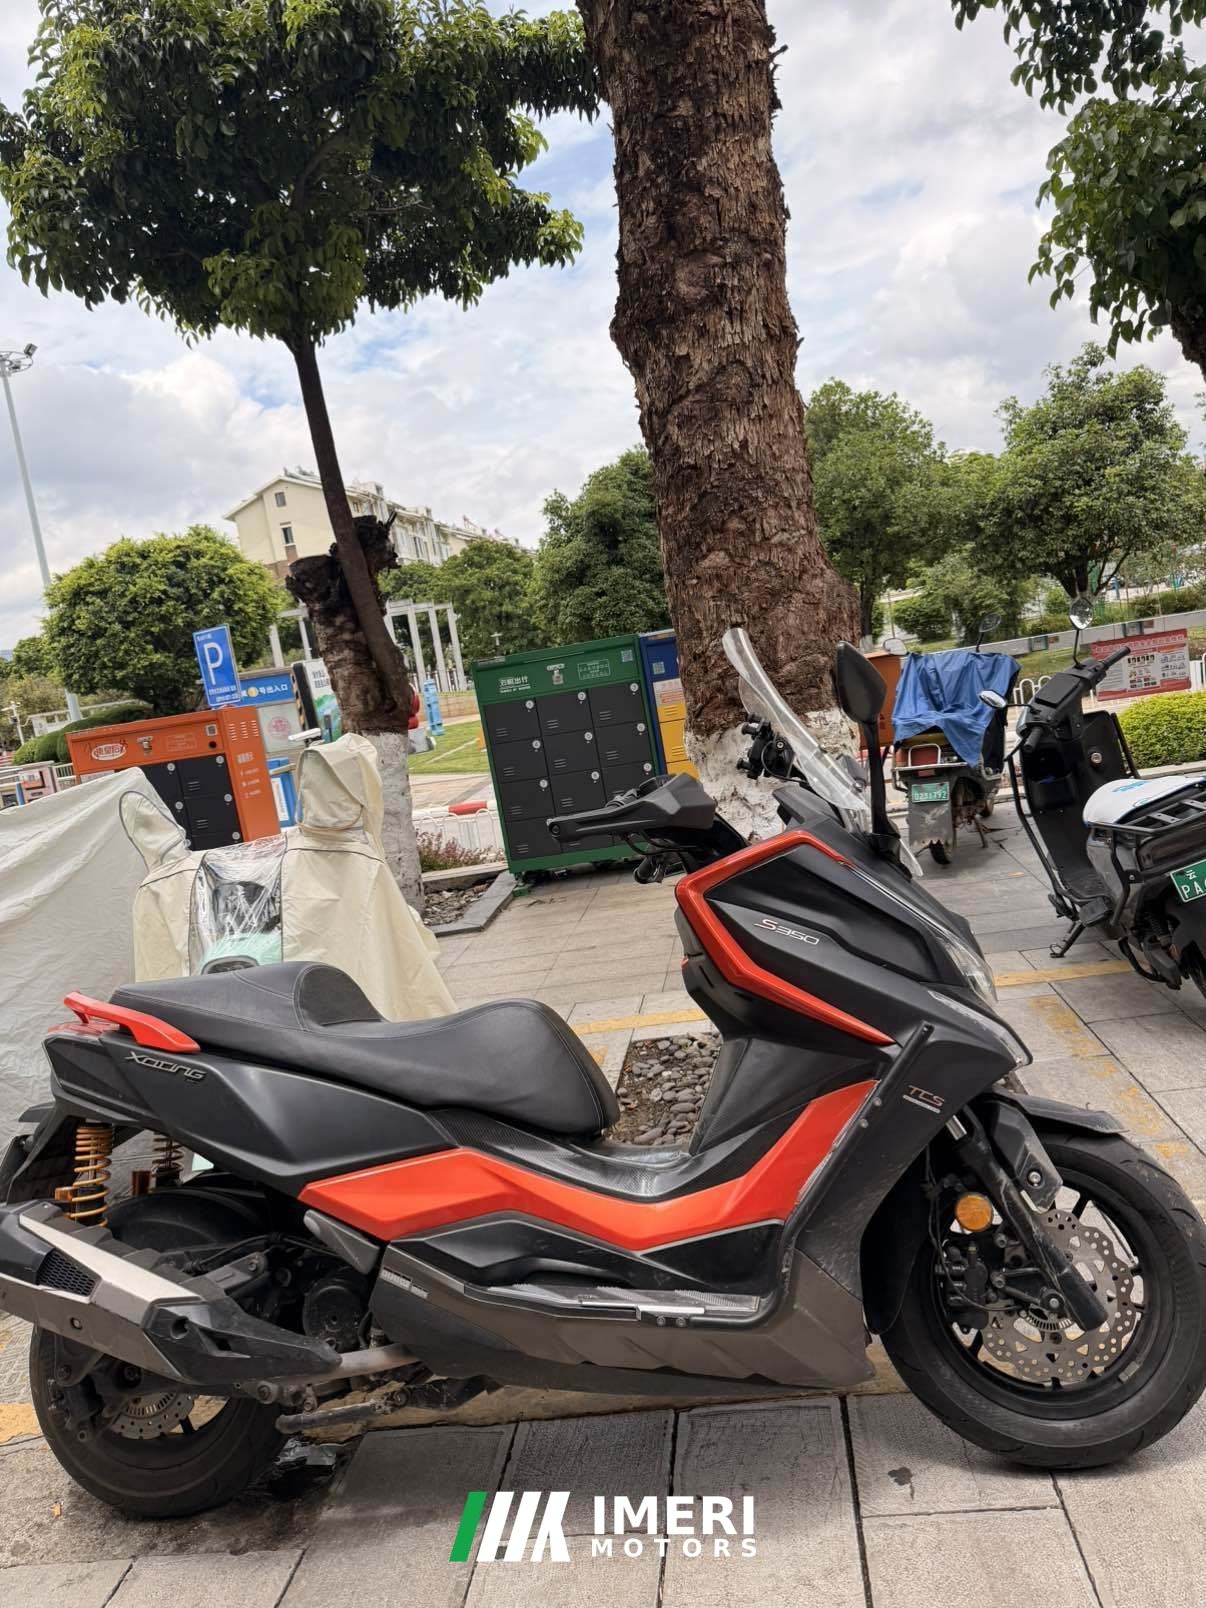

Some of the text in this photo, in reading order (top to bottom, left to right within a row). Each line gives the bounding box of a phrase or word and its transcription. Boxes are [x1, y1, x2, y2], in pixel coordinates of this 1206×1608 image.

[203, 642, 223, 686] P
[1181, 879, 1206, 899] PA
[753, 918, 820, 945] S350
[908, 1084, 945, 1107] TCS
